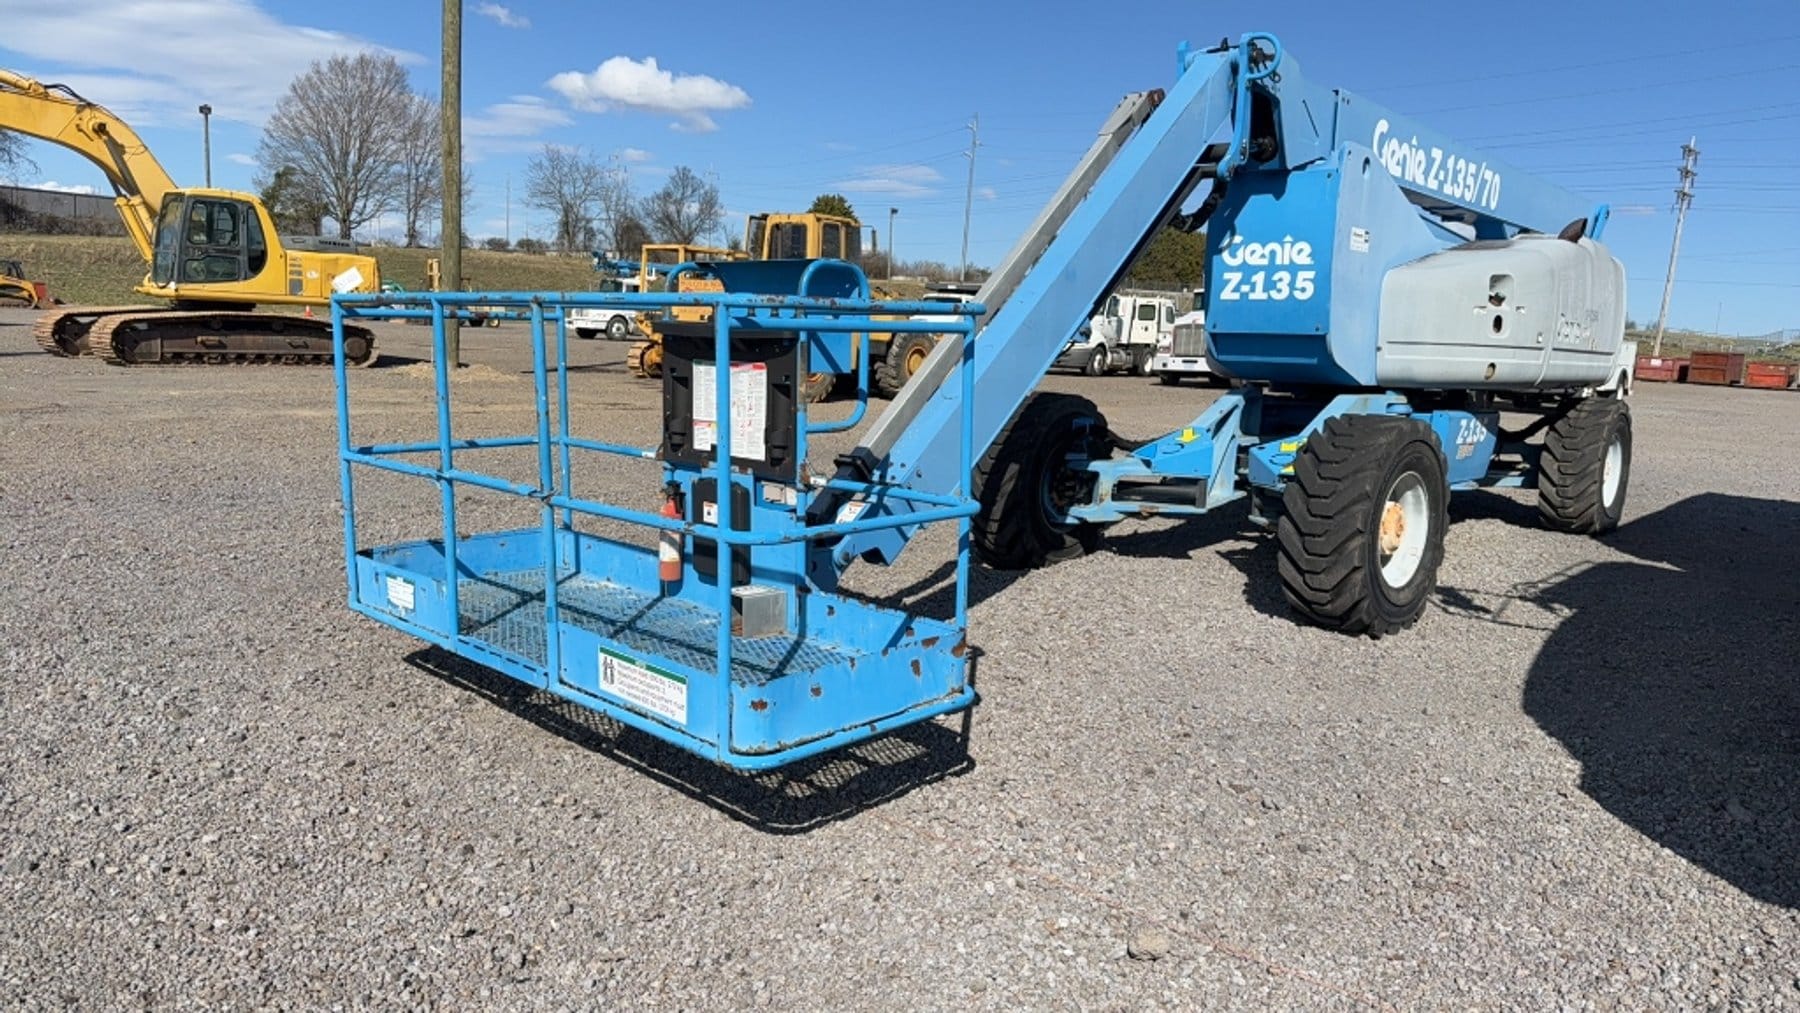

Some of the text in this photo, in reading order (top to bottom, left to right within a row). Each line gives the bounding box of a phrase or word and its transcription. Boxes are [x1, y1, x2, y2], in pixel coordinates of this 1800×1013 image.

[1373, 118, 1500, 211] Genie Z-135/70
[1221, 234, 1313, 266] Genie
[1220, 271, 1316, 300] Z-135
